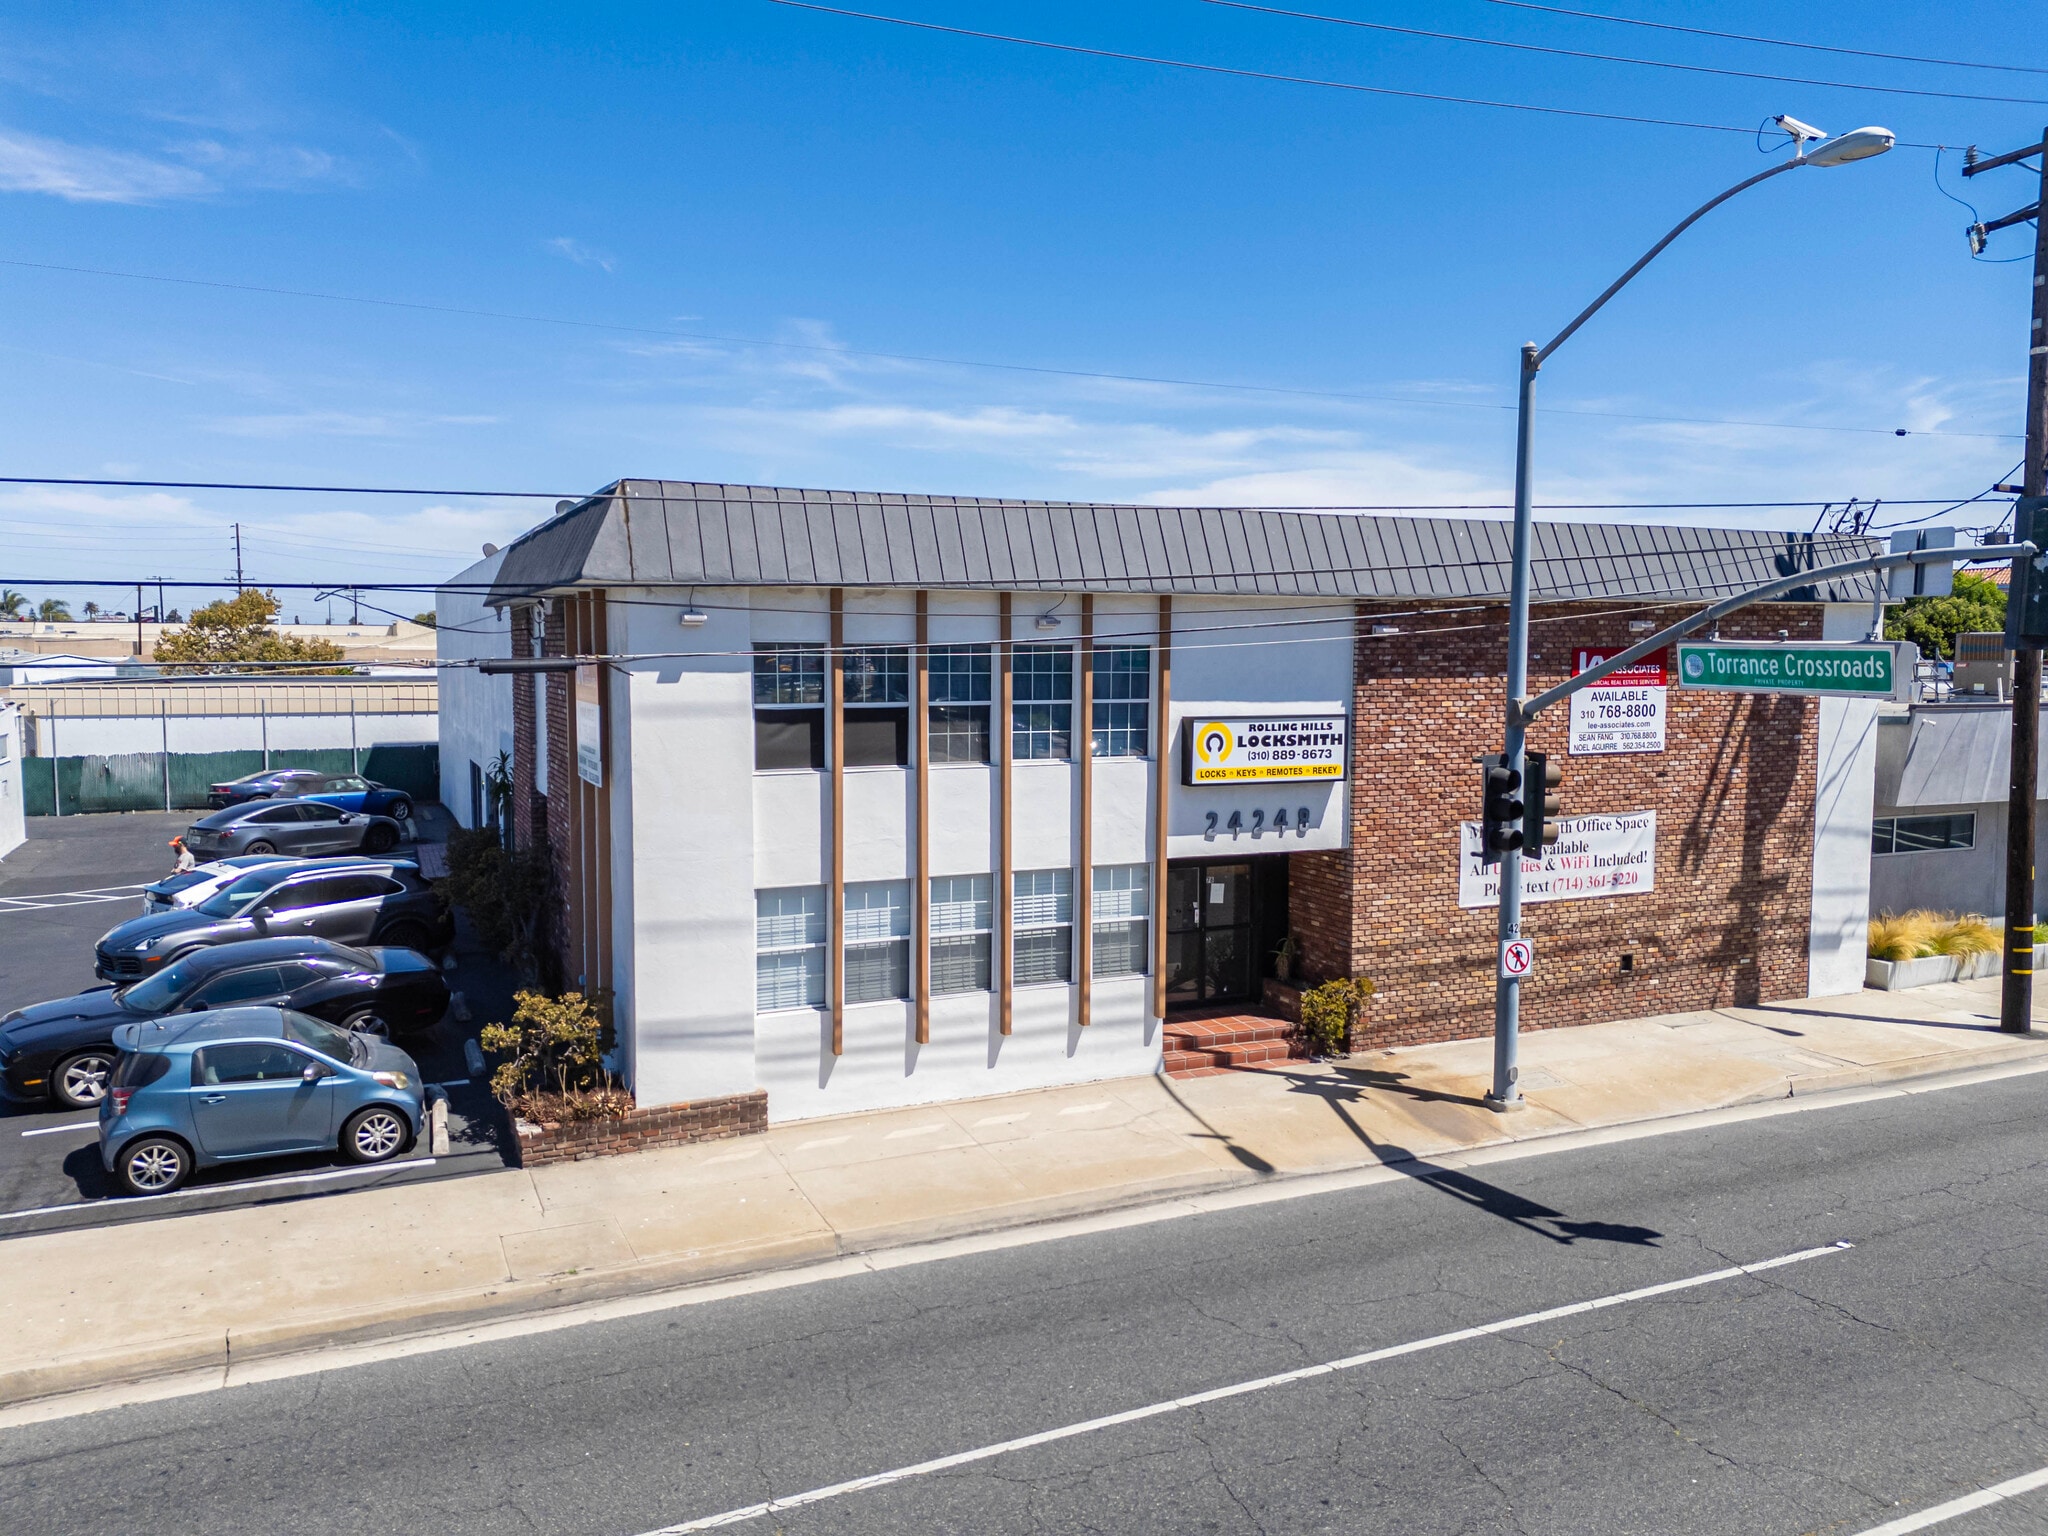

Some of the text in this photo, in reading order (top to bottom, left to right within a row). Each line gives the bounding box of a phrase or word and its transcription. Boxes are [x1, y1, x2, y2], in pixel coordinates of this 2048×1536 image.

[1708, 652, 1884, 678] Torrance Crossroads
[1590, 690, 1648, 702] AVAILABLE
[1580, 704, 1656, 719] 310 768-8800
[1248, 722, 1333, 732] ROLLING HILLS
[1237, 733, 1342, 748] LOCKSMITH
[1620, 732, 1657, 740] 310.768.8800
[1622, 741, 1661, 750] 562.354.2500
[1248, 749, 1332, 761] (310) 889-8673
[1200, 766, 1338, 778] LOCKS KEYS REMOTES REKEY
[1204, 807, 1310, 839] 24248
[1576, 818, 1612, 832] Office
[1615, 816, 1649, 833] Space
[1543, 840, 1589, 855] vailable
[1470, 864, 1488, 876] All
[1545, 858, 1555, 871] &
[1560, 855, 1589, 870] WiFi
[1594, 850, 1648, 867] Included!
[1527, 880, 1549, 893] text
[1553, 876, 1583, 894] (714)
[1587, 871, 1638, 889] 361-5220
